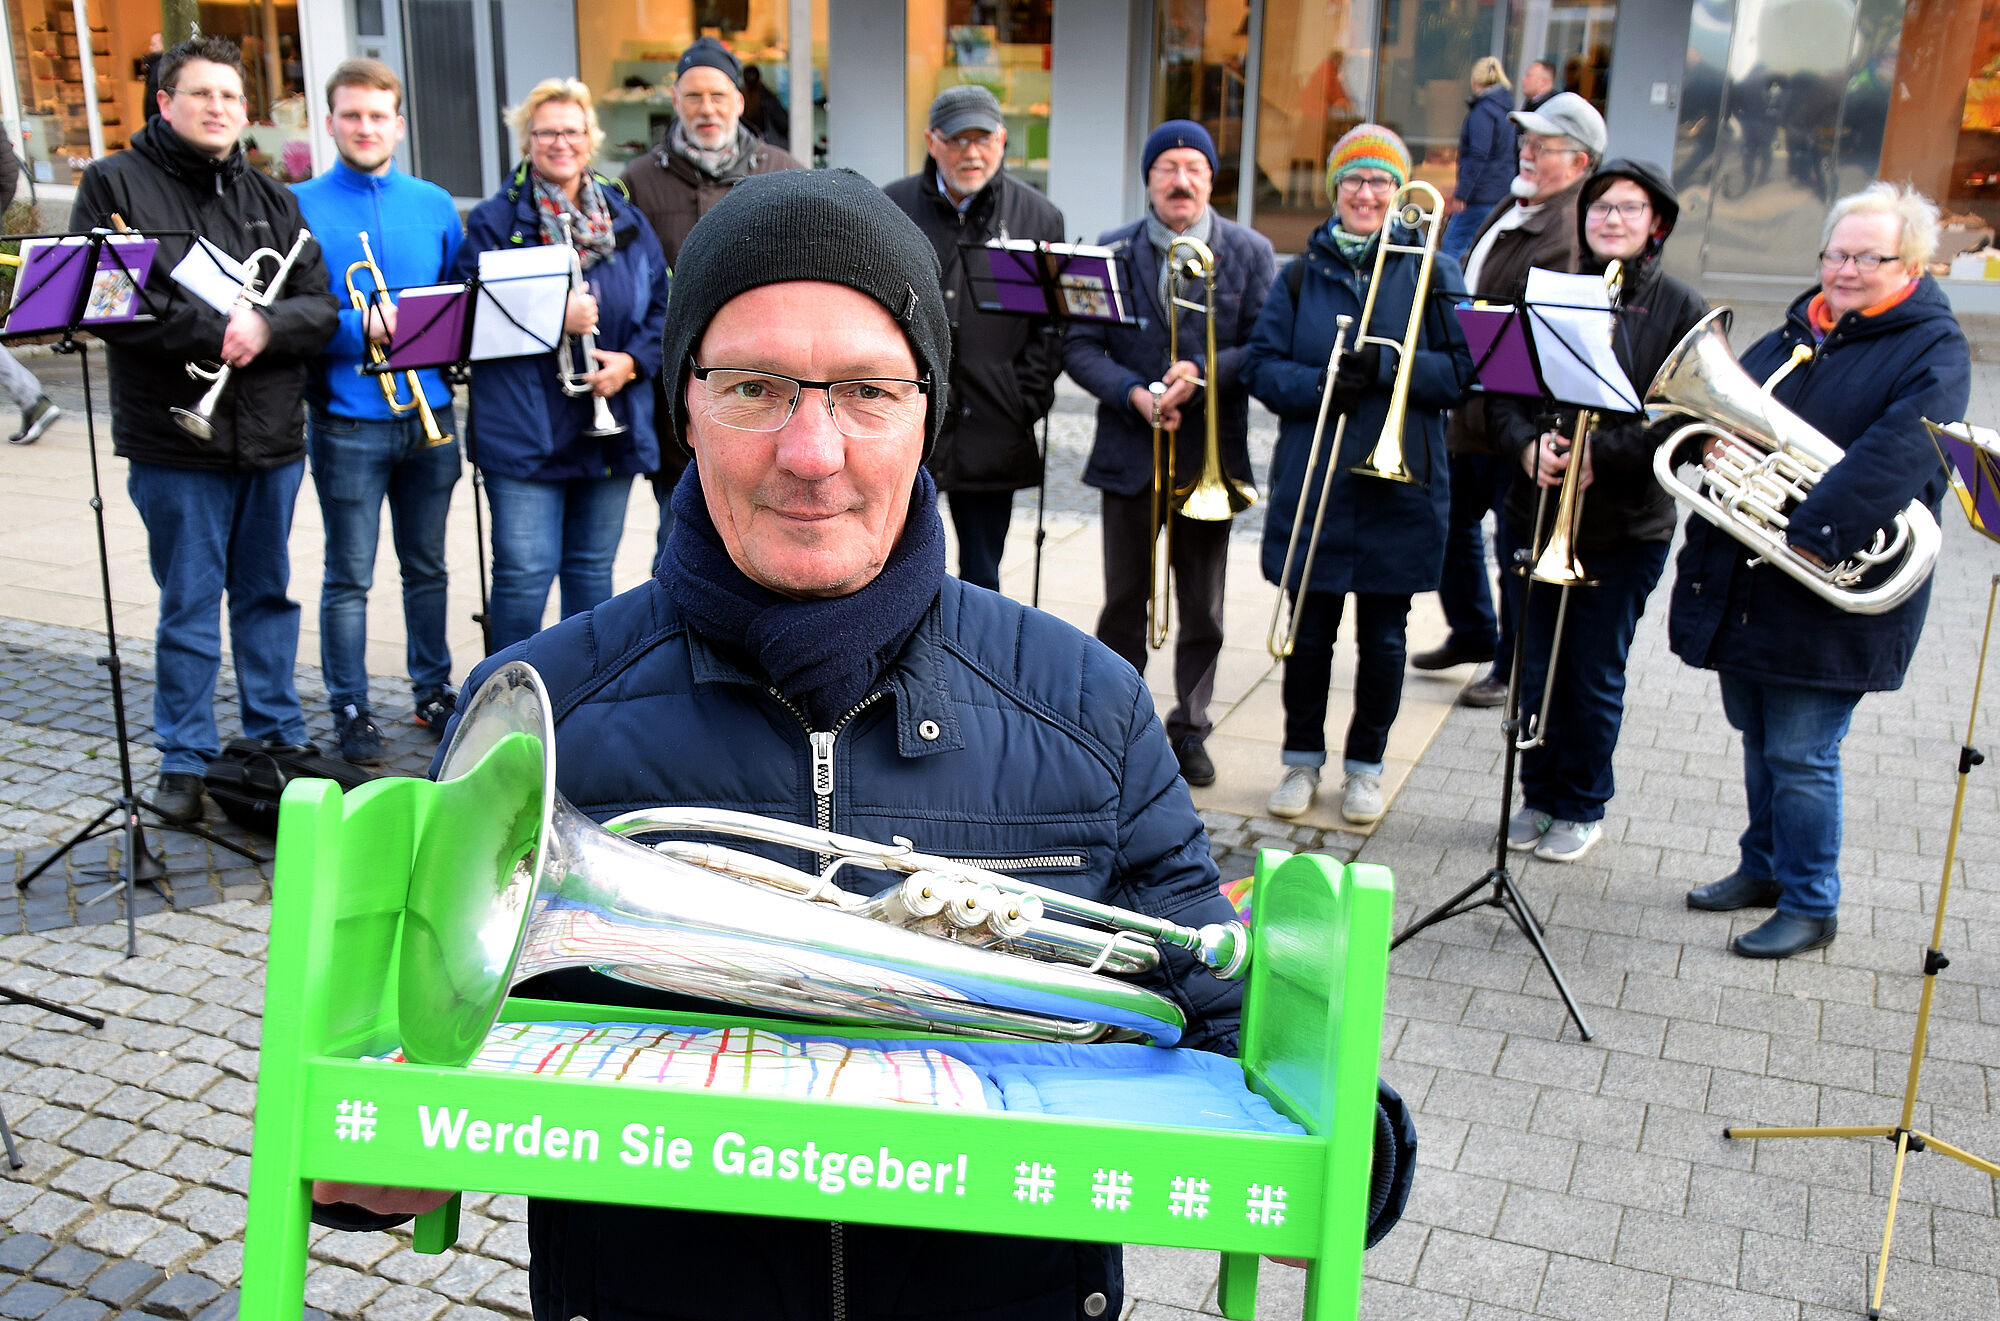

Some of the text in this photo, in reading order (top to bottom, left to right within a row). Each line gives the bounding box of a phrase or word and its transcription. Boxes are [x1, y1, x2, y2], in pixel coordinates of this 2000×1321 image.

[418, 1105, 968, 1195] Werden Sie Gastgeber!
